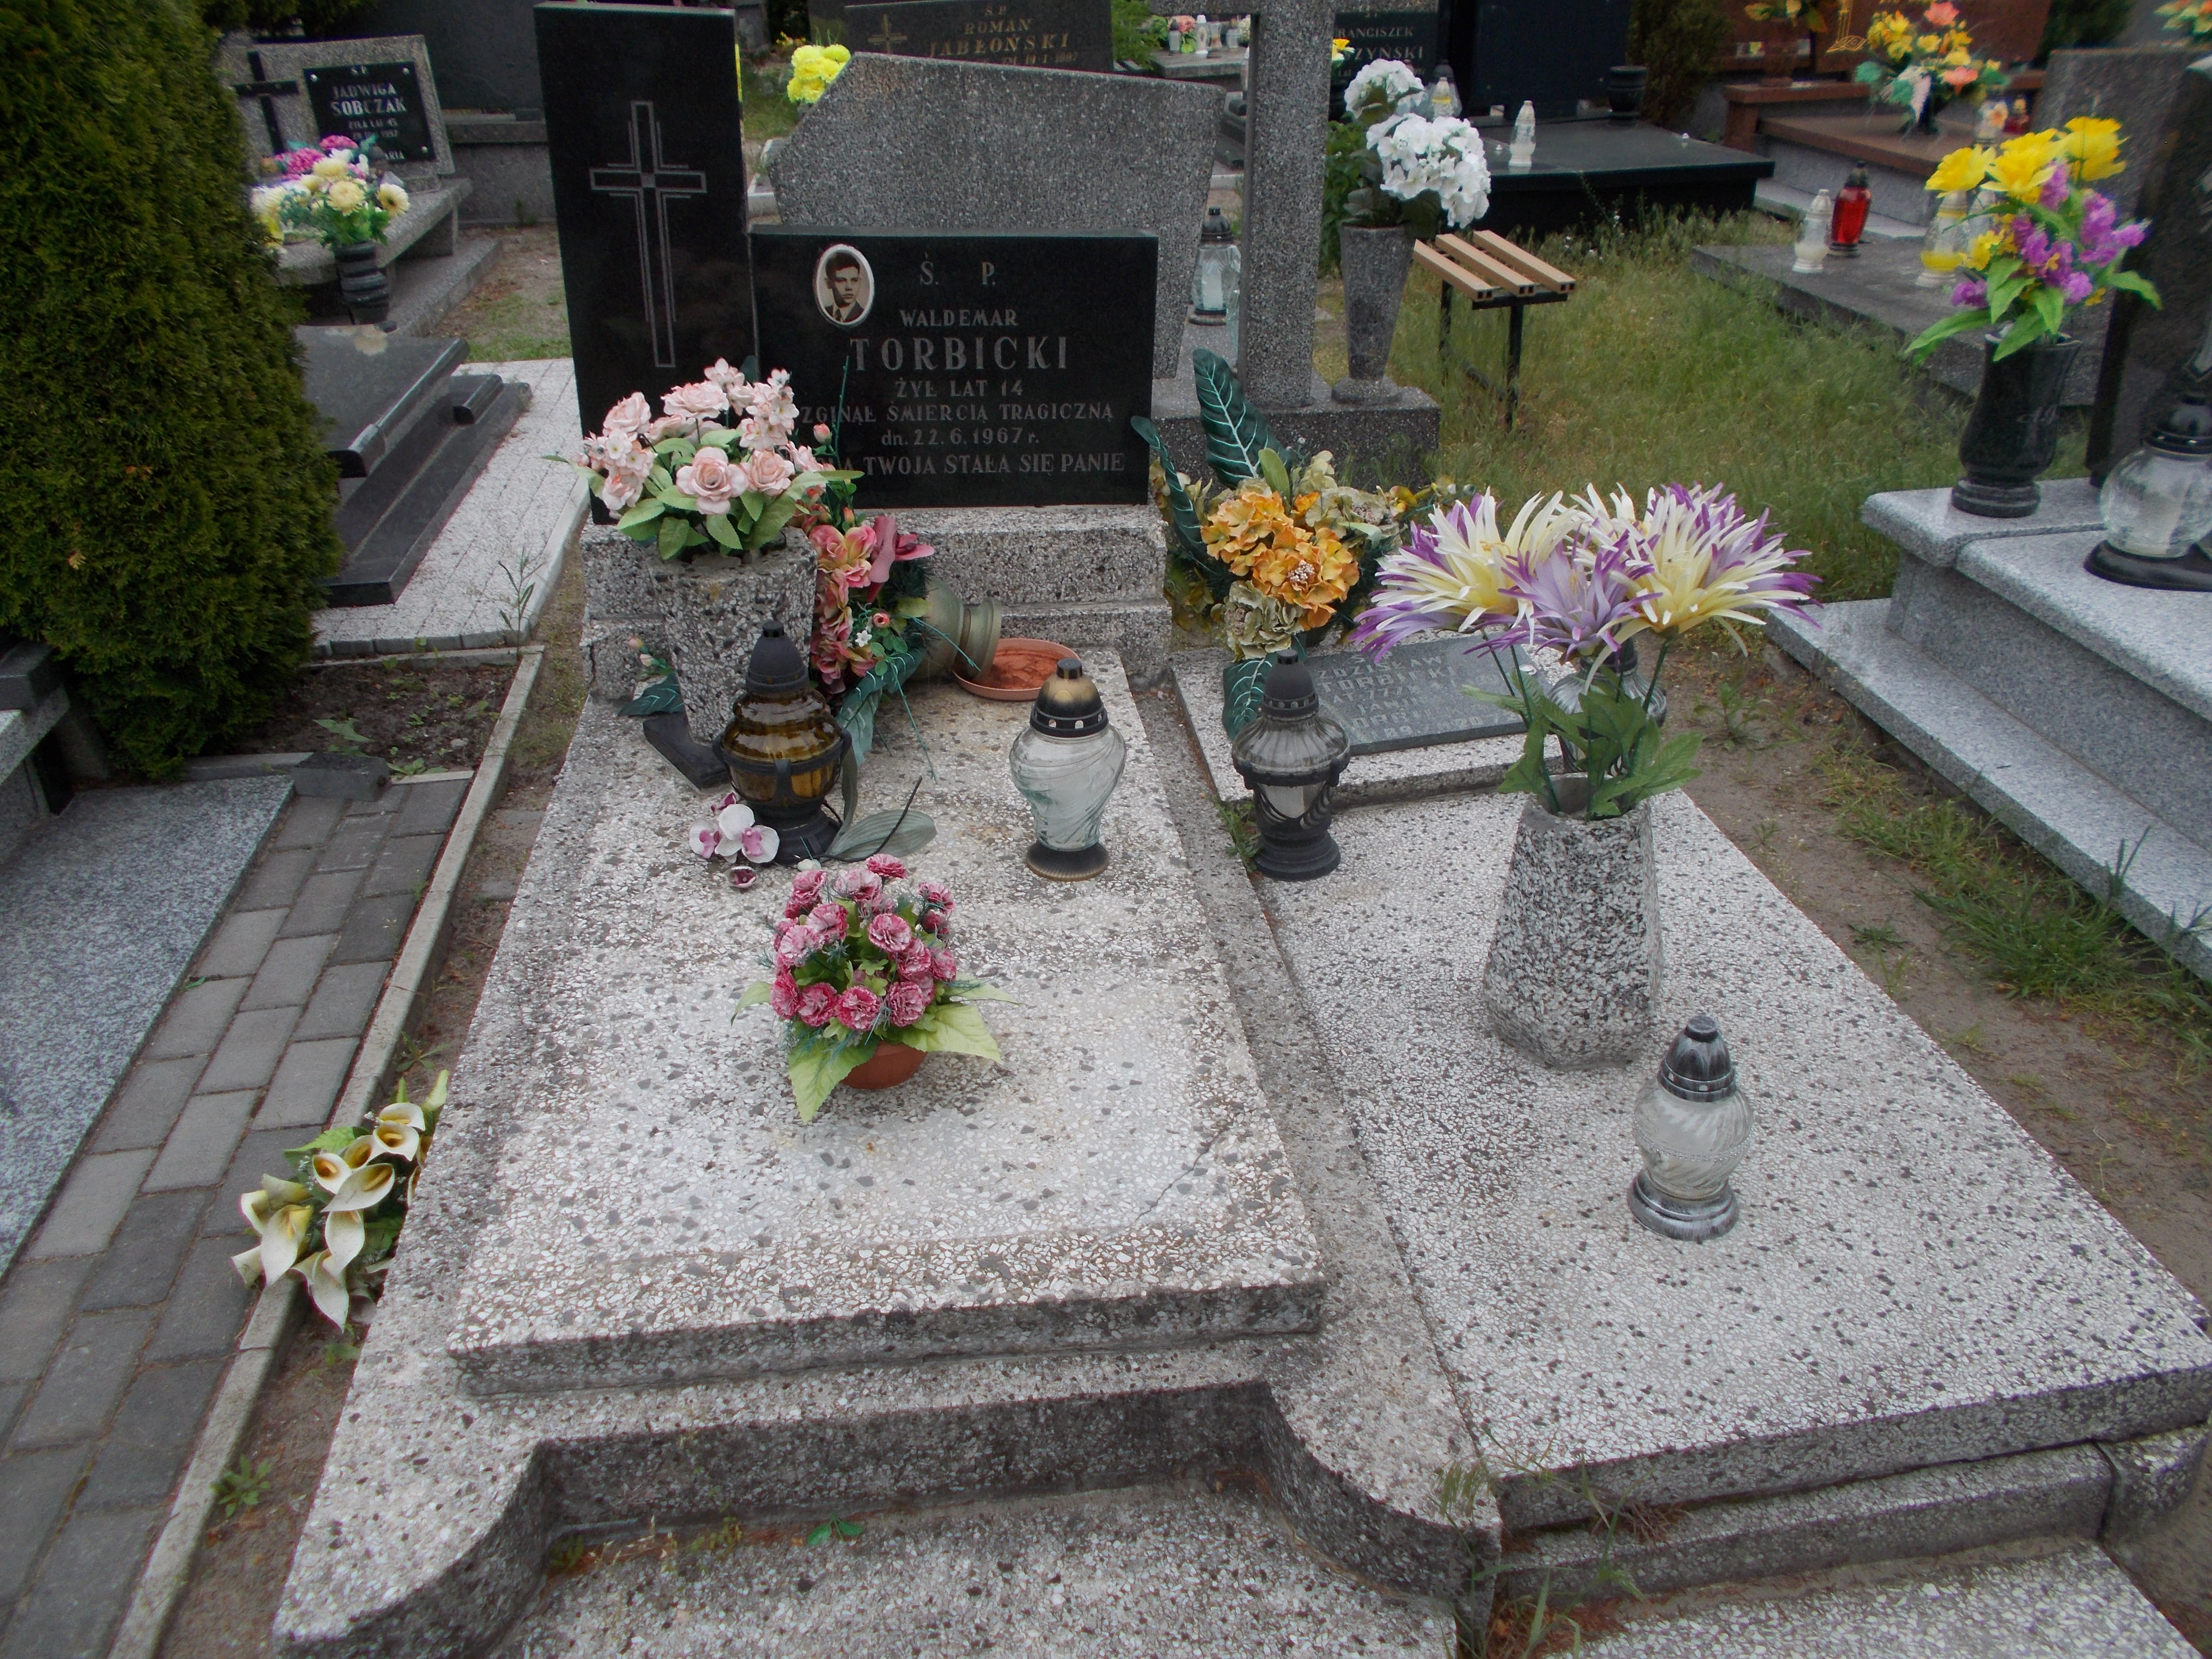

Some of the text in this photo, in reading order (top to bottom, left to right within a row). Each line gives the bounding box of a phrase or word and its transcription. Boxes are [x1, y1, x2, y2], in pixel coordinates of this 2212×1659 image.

[963, 18, 1032, 35] ROMAN
[1334, 26, 1413, 38] RANCISZEK
[928, 32, 1069, 58] JABŁOŃSKI
[1346, 46, 1423, 60] ZYŃSKI
[332, 83, 397, 98] JADWIGA
[330, 97, 407, 116] SOBCZAK
[384, 150, 405, 160] ARIA
[900, 309, 1019, 327] WALDEMAR
[849, 336, 1068, 372] TORBICKI
[895, 377, 1023, 398] ŻYŁ LAT 14
[801, 402, 1114, 425] ZGINĄŁ ŚMIERCIĄ TRAGICZNĄ
[864, 456, 937, 476] TWOJA
[943, 455, 1011, 474] STAŁA
[1019, 454, 1055, 476] SIĘ
[1060, 453, 1125, 473] PANIE
